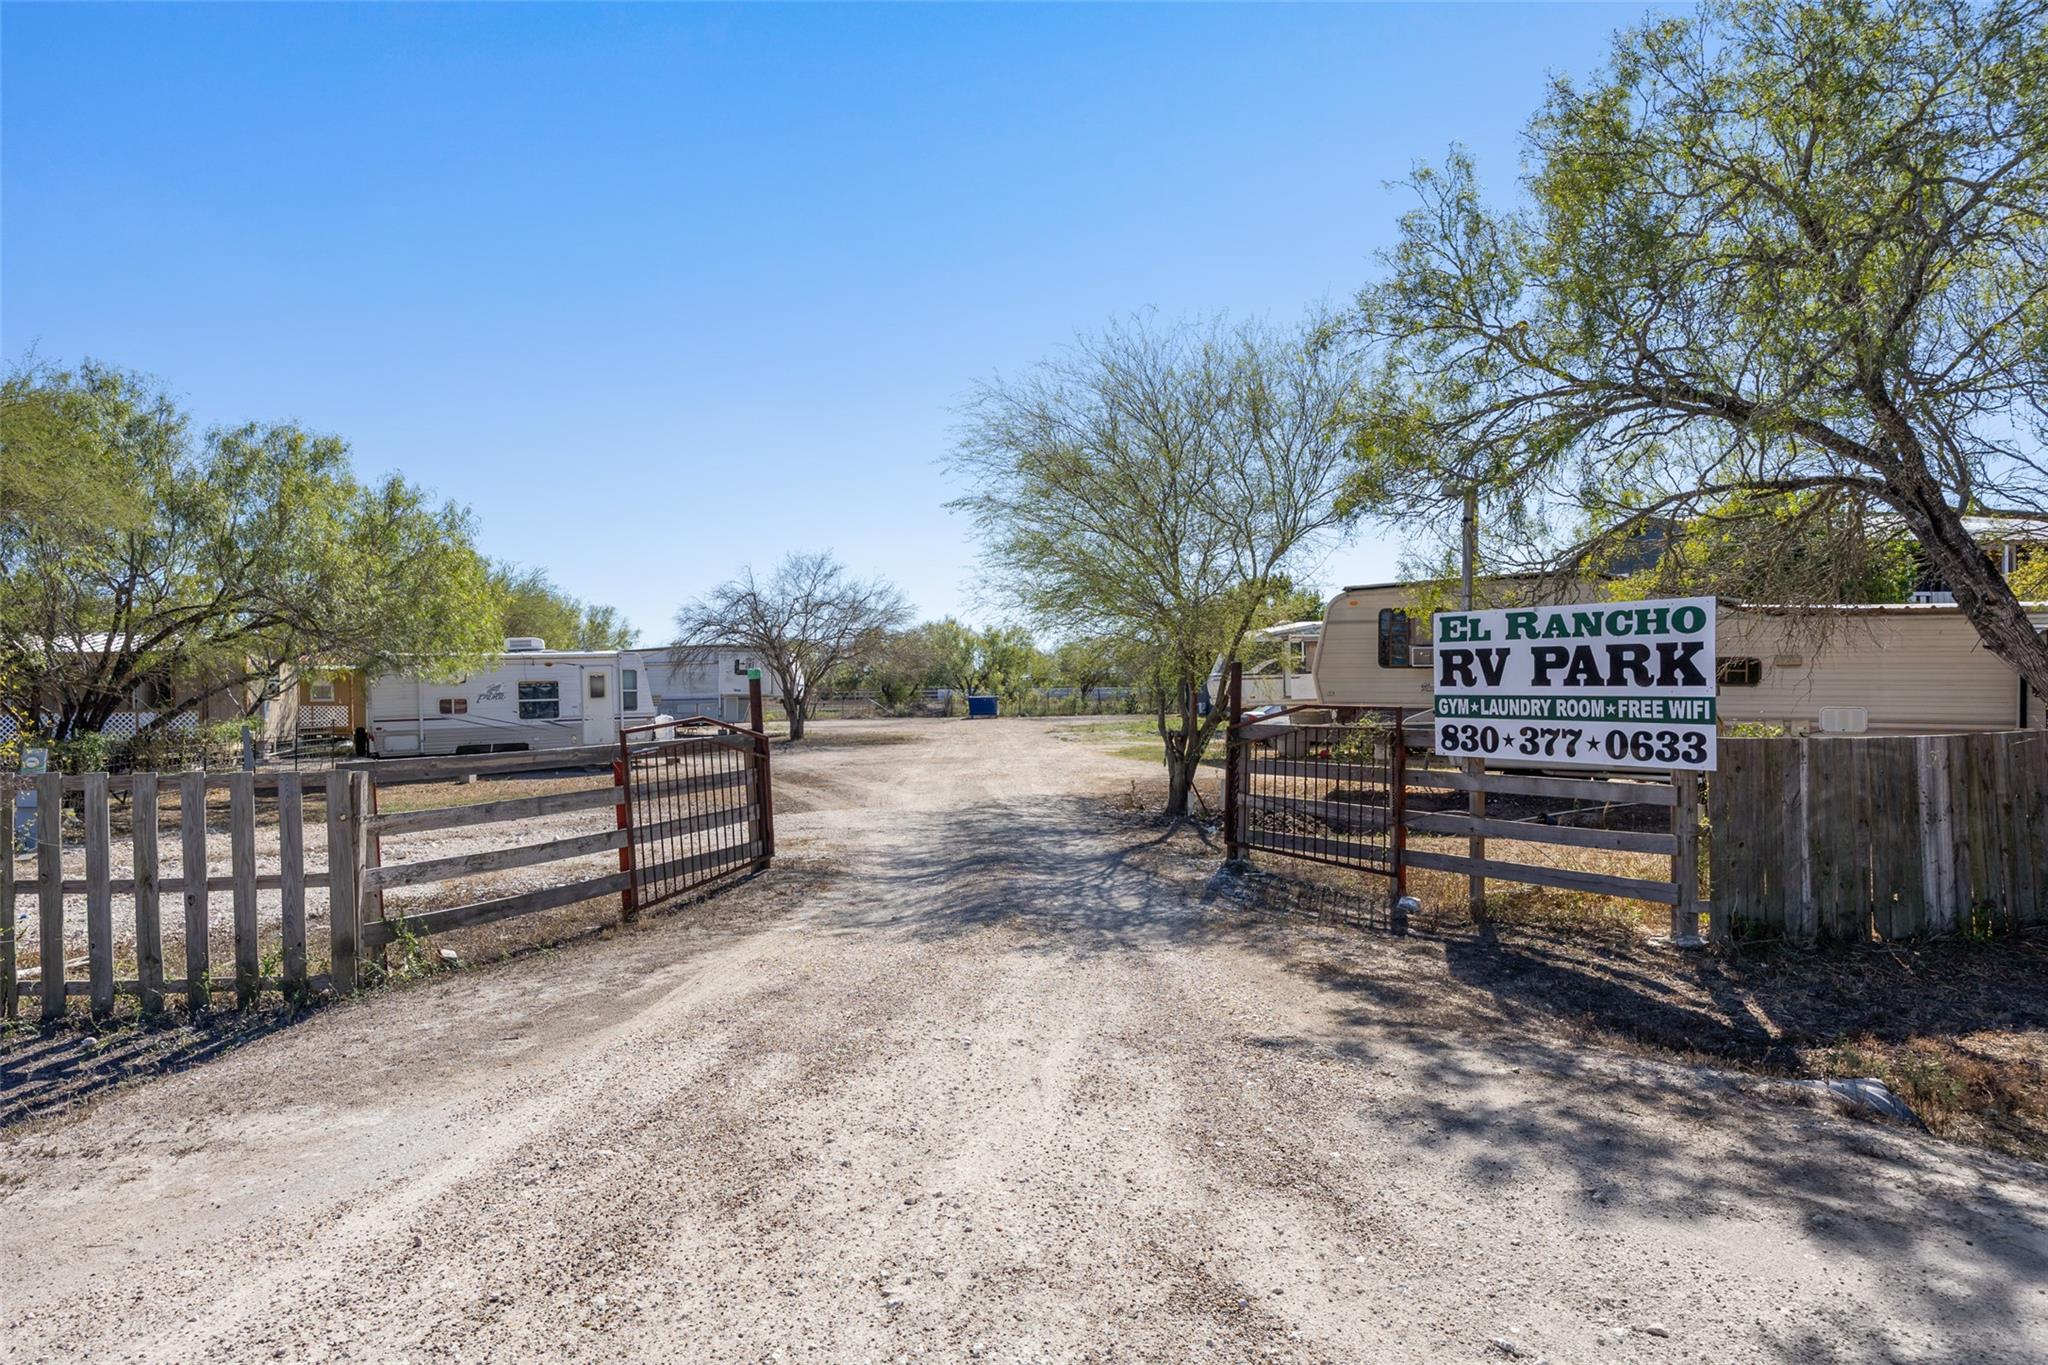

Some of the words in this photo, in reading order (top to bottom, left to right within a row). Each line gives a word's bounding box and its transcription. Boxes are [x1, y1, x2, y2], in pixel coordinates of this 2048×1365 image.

[1440, 616, 1491, 642] EL
[1505, 606, 1706, 640] RANCHO
[1440, 648, 1510, 687] RV
[1531, 641, 1706, 687] PARK
[1439, 698, 1469, 715] GYM
[1481, 698, 1551, 716] LAUNDRY
[1556, 699, 1604, 717] ROOM
[1618, 699, 1664, 718] FREE
[1668, 700, 1710, 719] WIFI
[1441, 724, 1499, 753] 830
[1519, 726, 1582, 757] 377
[1605, 729, 1707, 764] 0633
